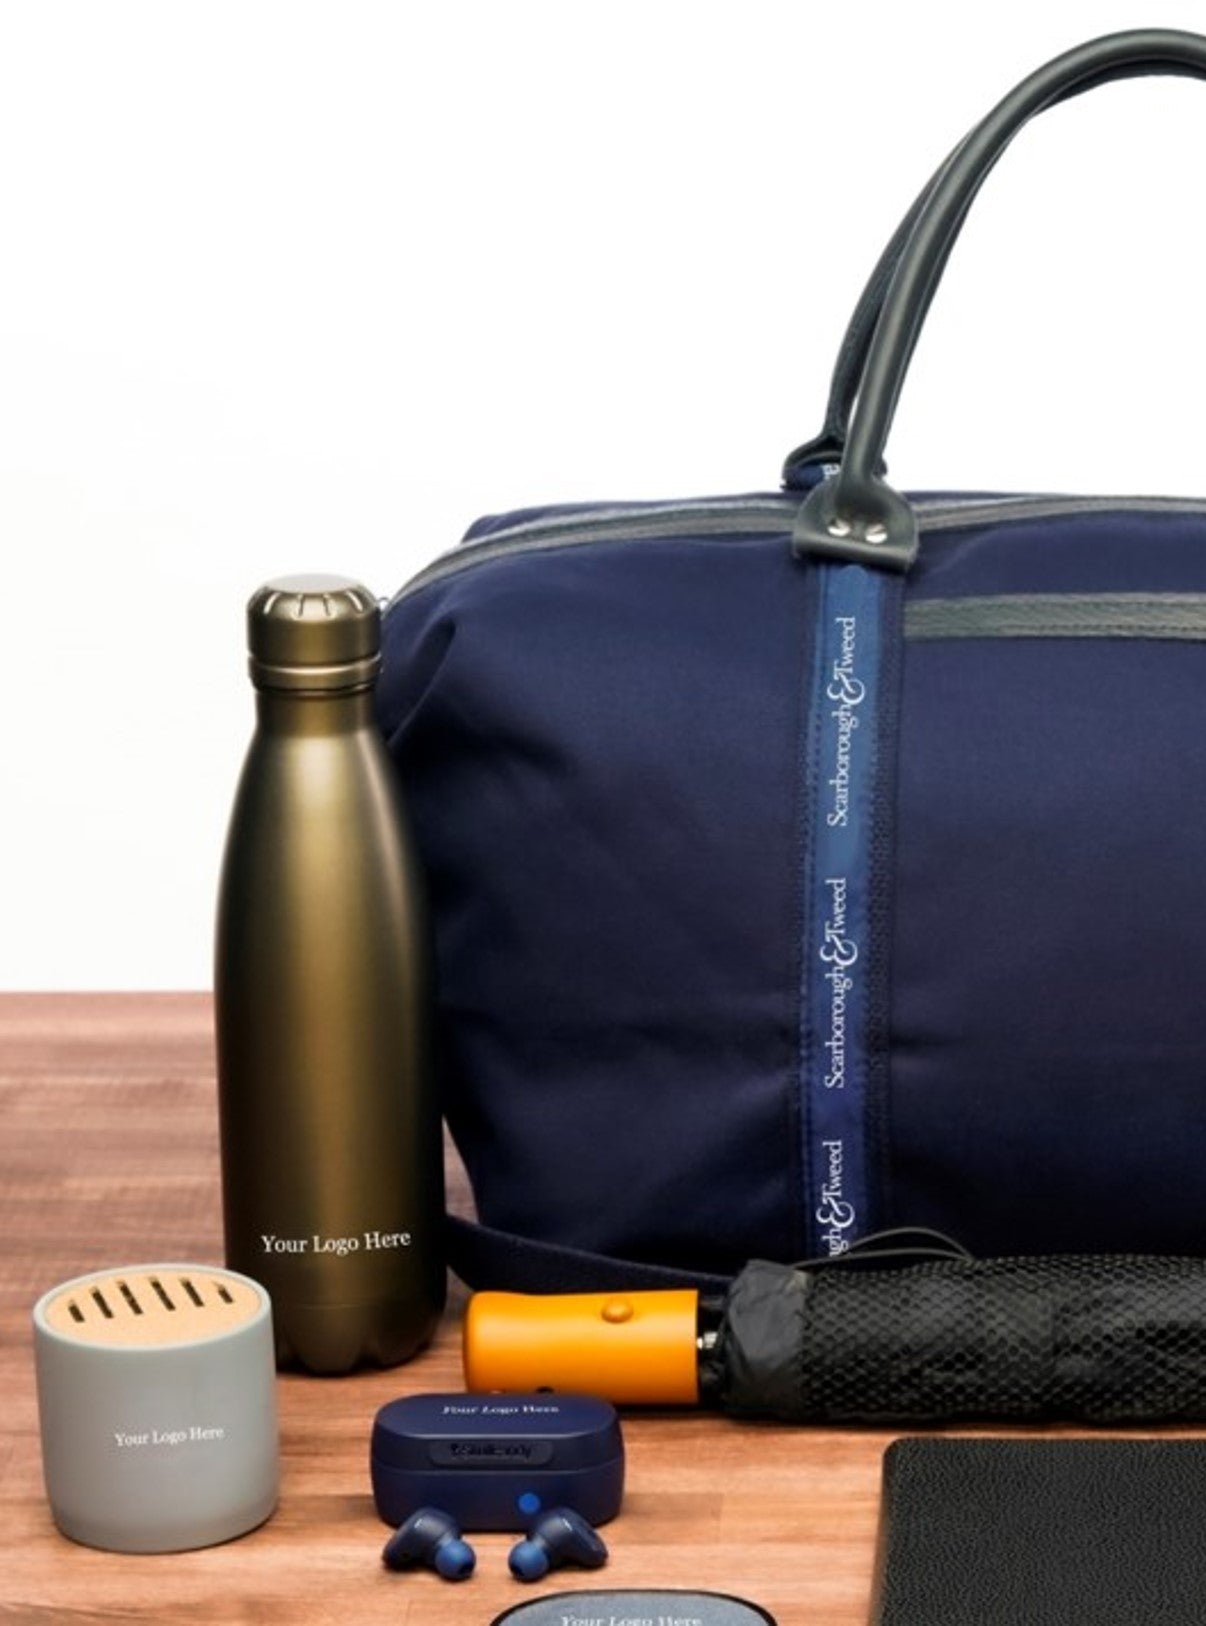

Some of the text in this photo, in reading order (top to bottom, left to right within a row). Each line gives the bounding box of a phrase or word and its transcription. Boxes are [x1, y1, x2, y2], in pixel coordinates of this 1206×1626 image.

[827, 617, 865, 827] Scarborough&Tweed
[820, 878, 858, 1089] Scarborough&Tweed
[261, 1231, 412, 1257] Your Logo Here
[114, 1426, 224, 1447] Your Logo Here
